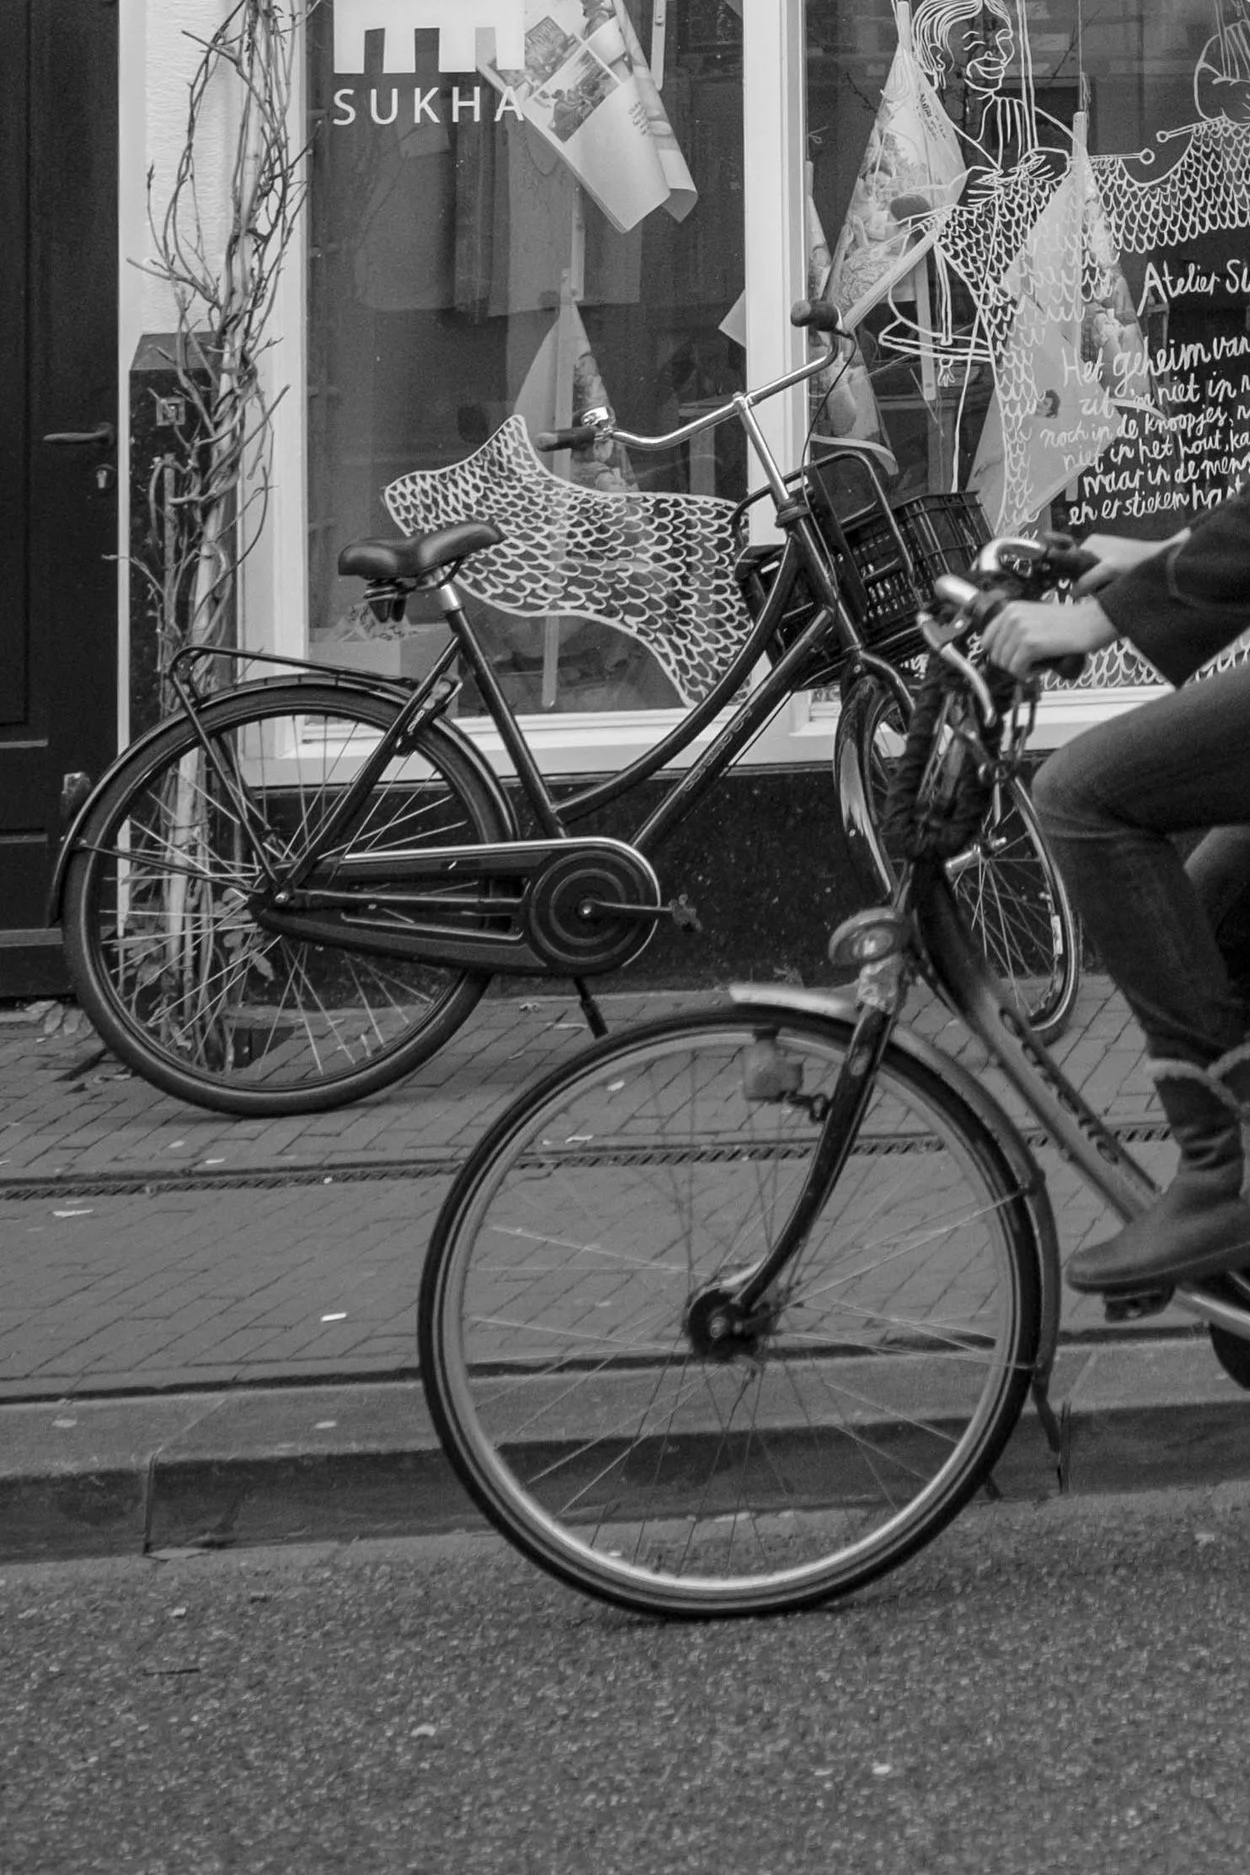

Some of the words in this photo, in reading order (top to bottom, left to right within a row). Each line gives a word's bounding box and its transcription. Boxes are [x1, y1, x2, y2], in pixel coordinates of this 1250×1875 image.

[331, 84, 525, 126] SUKHA
[1136, 259, 1221, 317] Atelier
[1061, 345, 1103, 388] Het
[1112, 335, 1211, 397] geheim
[1157, 371, 1201, 405] niet
[1208, 371, 1238, 400] in
[1090, 422, 1113, 445] in
[1116, 413, 1139, 440] de
[1063, 443, 1104, 474] niet
[1110, 442, 1135, 465] in
[1138, 435, 1174, 464] het
[1082, 470, 1144, 498] maar
[1147, 463, 1171, 486] in
[1174, 460, 1199, 484] de
[1067, 502, 1098, 526] en
[1101, 497, 1122, 520] er
[1122, 490, 1190, 518] stiekem
